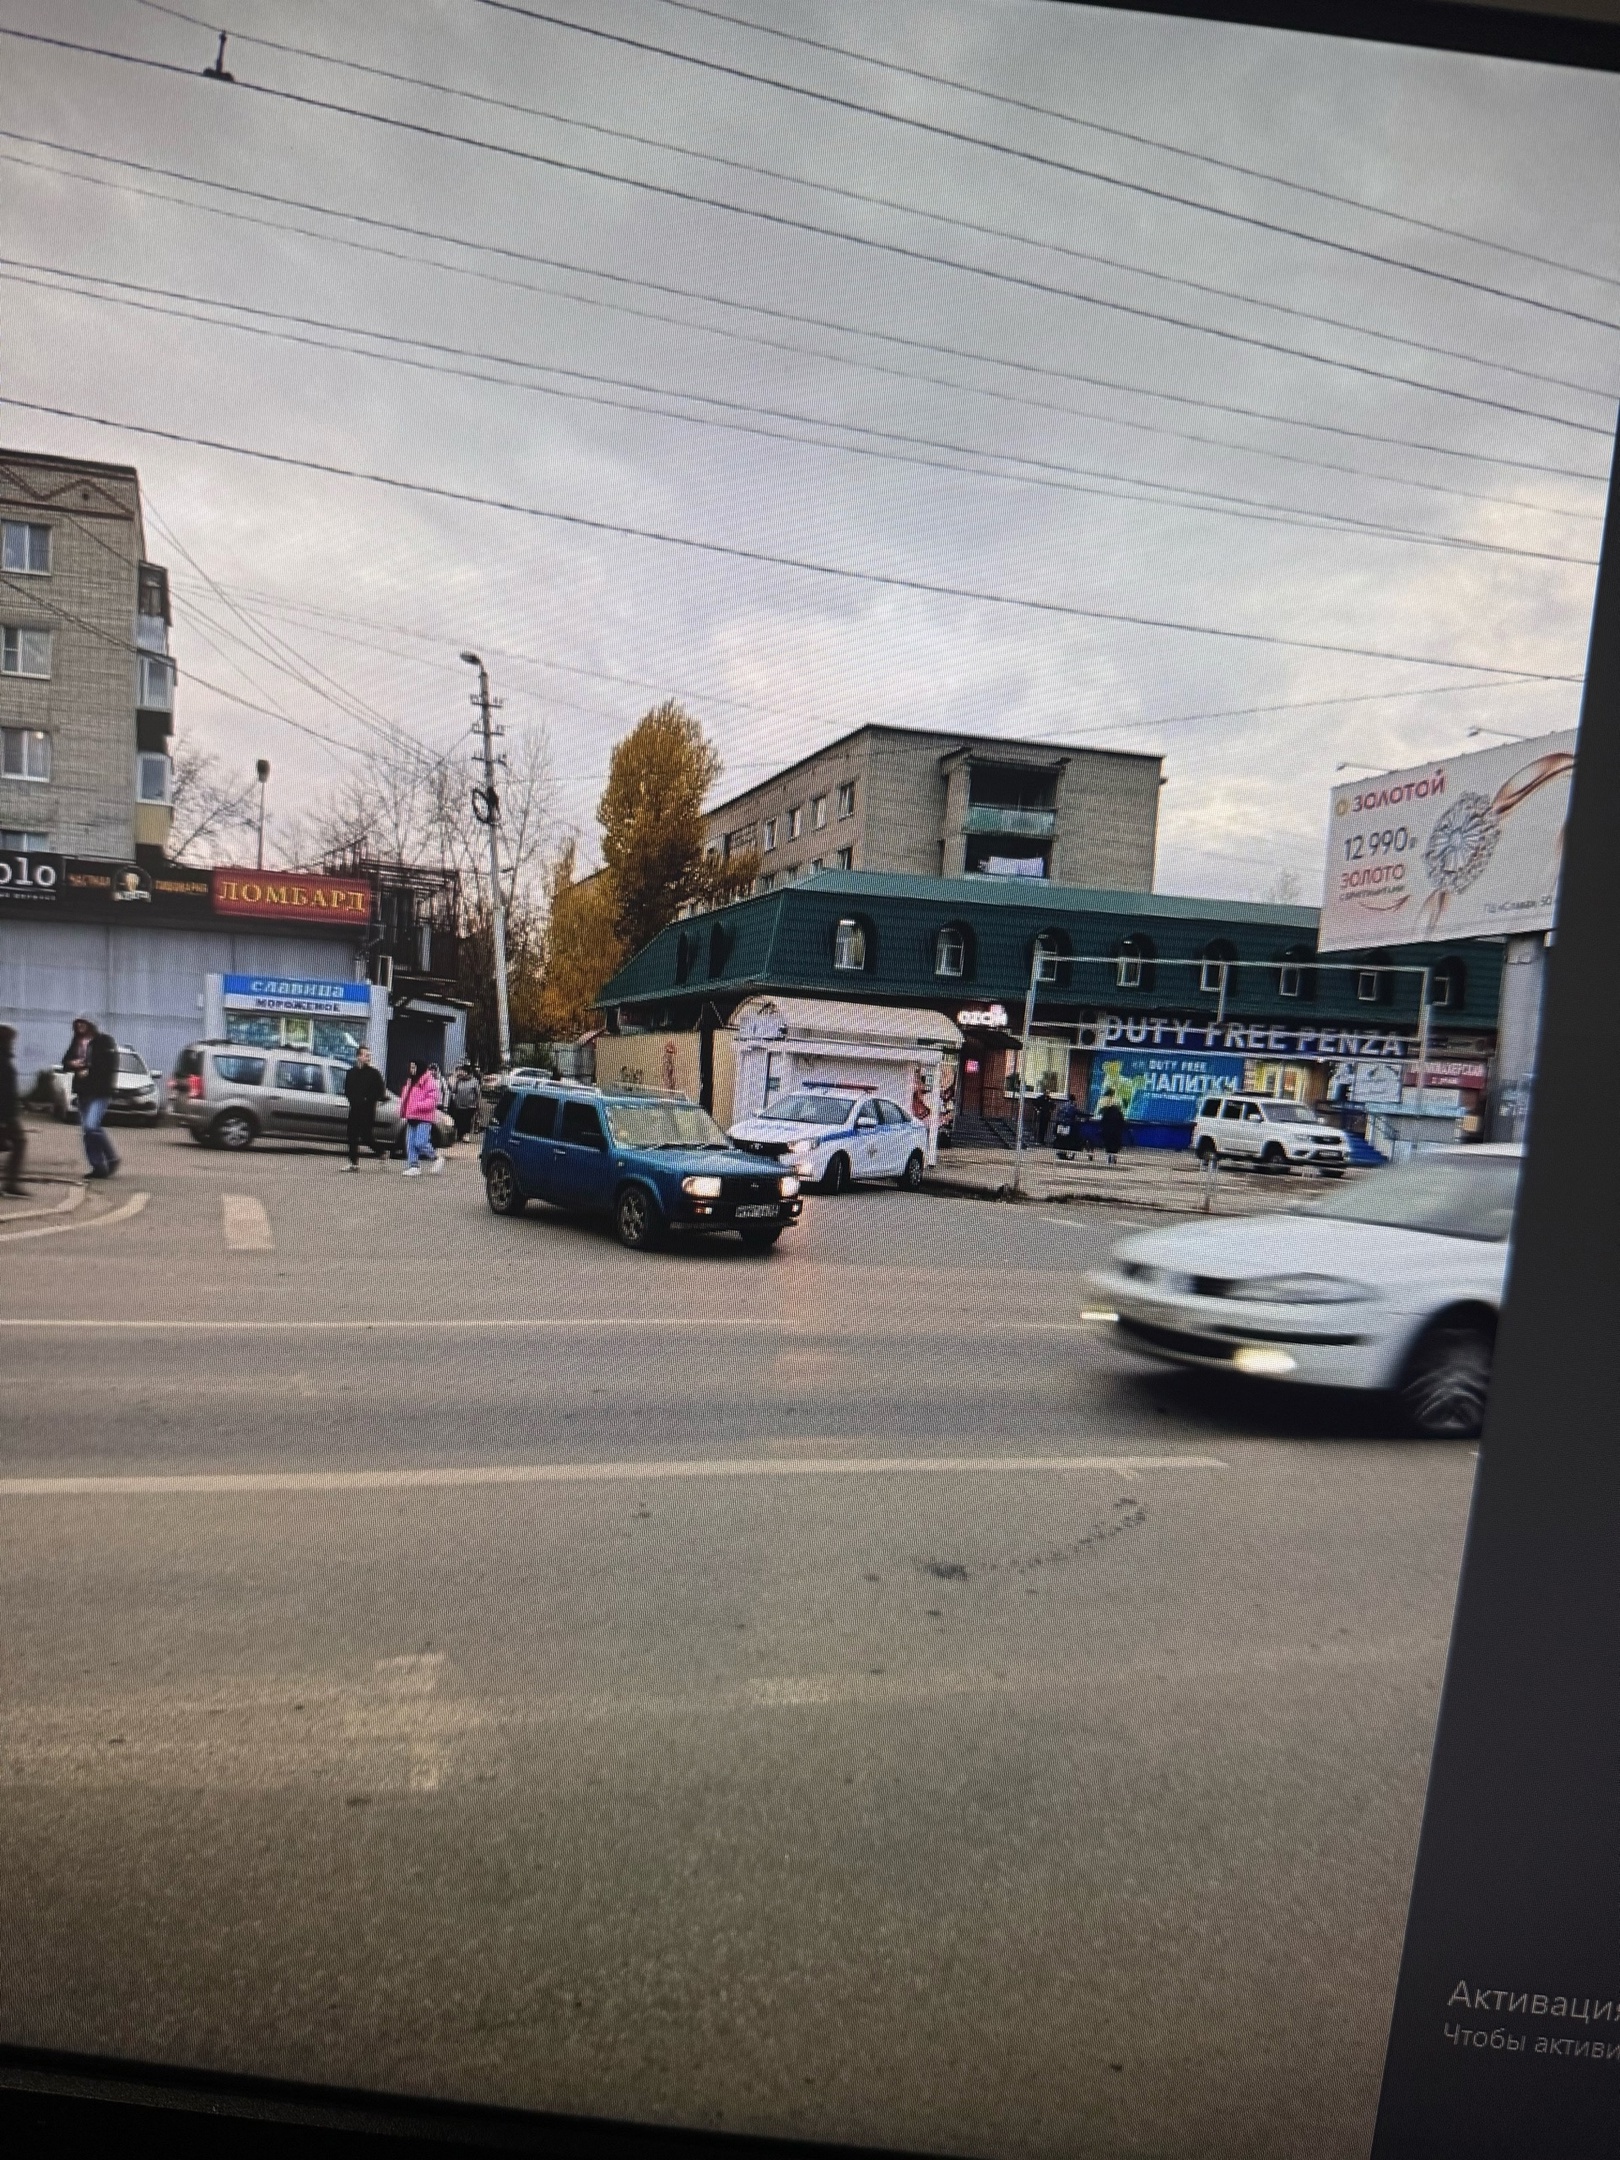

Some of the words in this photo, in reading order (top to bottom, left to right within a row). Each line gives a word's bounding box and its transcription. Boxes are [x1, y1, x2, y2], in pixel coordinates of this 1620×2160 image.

[1352, 768, 1447, 813] ЗОЛОТОЙ
[1340, 864, 1406, 889] ЗОЛОТО
[219, 881, 366, 913] ЛОМБАРД
[255, 998, 341, 1013] МОРОЖЕНОЕ
[1102, 1014, 1192, 1045] DUTY
[1203, 1020, 1288, 1050] FREE
[1296, 1026, 1403, 1056] PENZA
[1148, 1058, 1178, 1072] DUTY
[1180, 1060, 1208, 1073] FREE
[1144, 1071, 1240, 1094] НАПИТКИ
[1443, 2022, 1527, 2052] Чтобы
